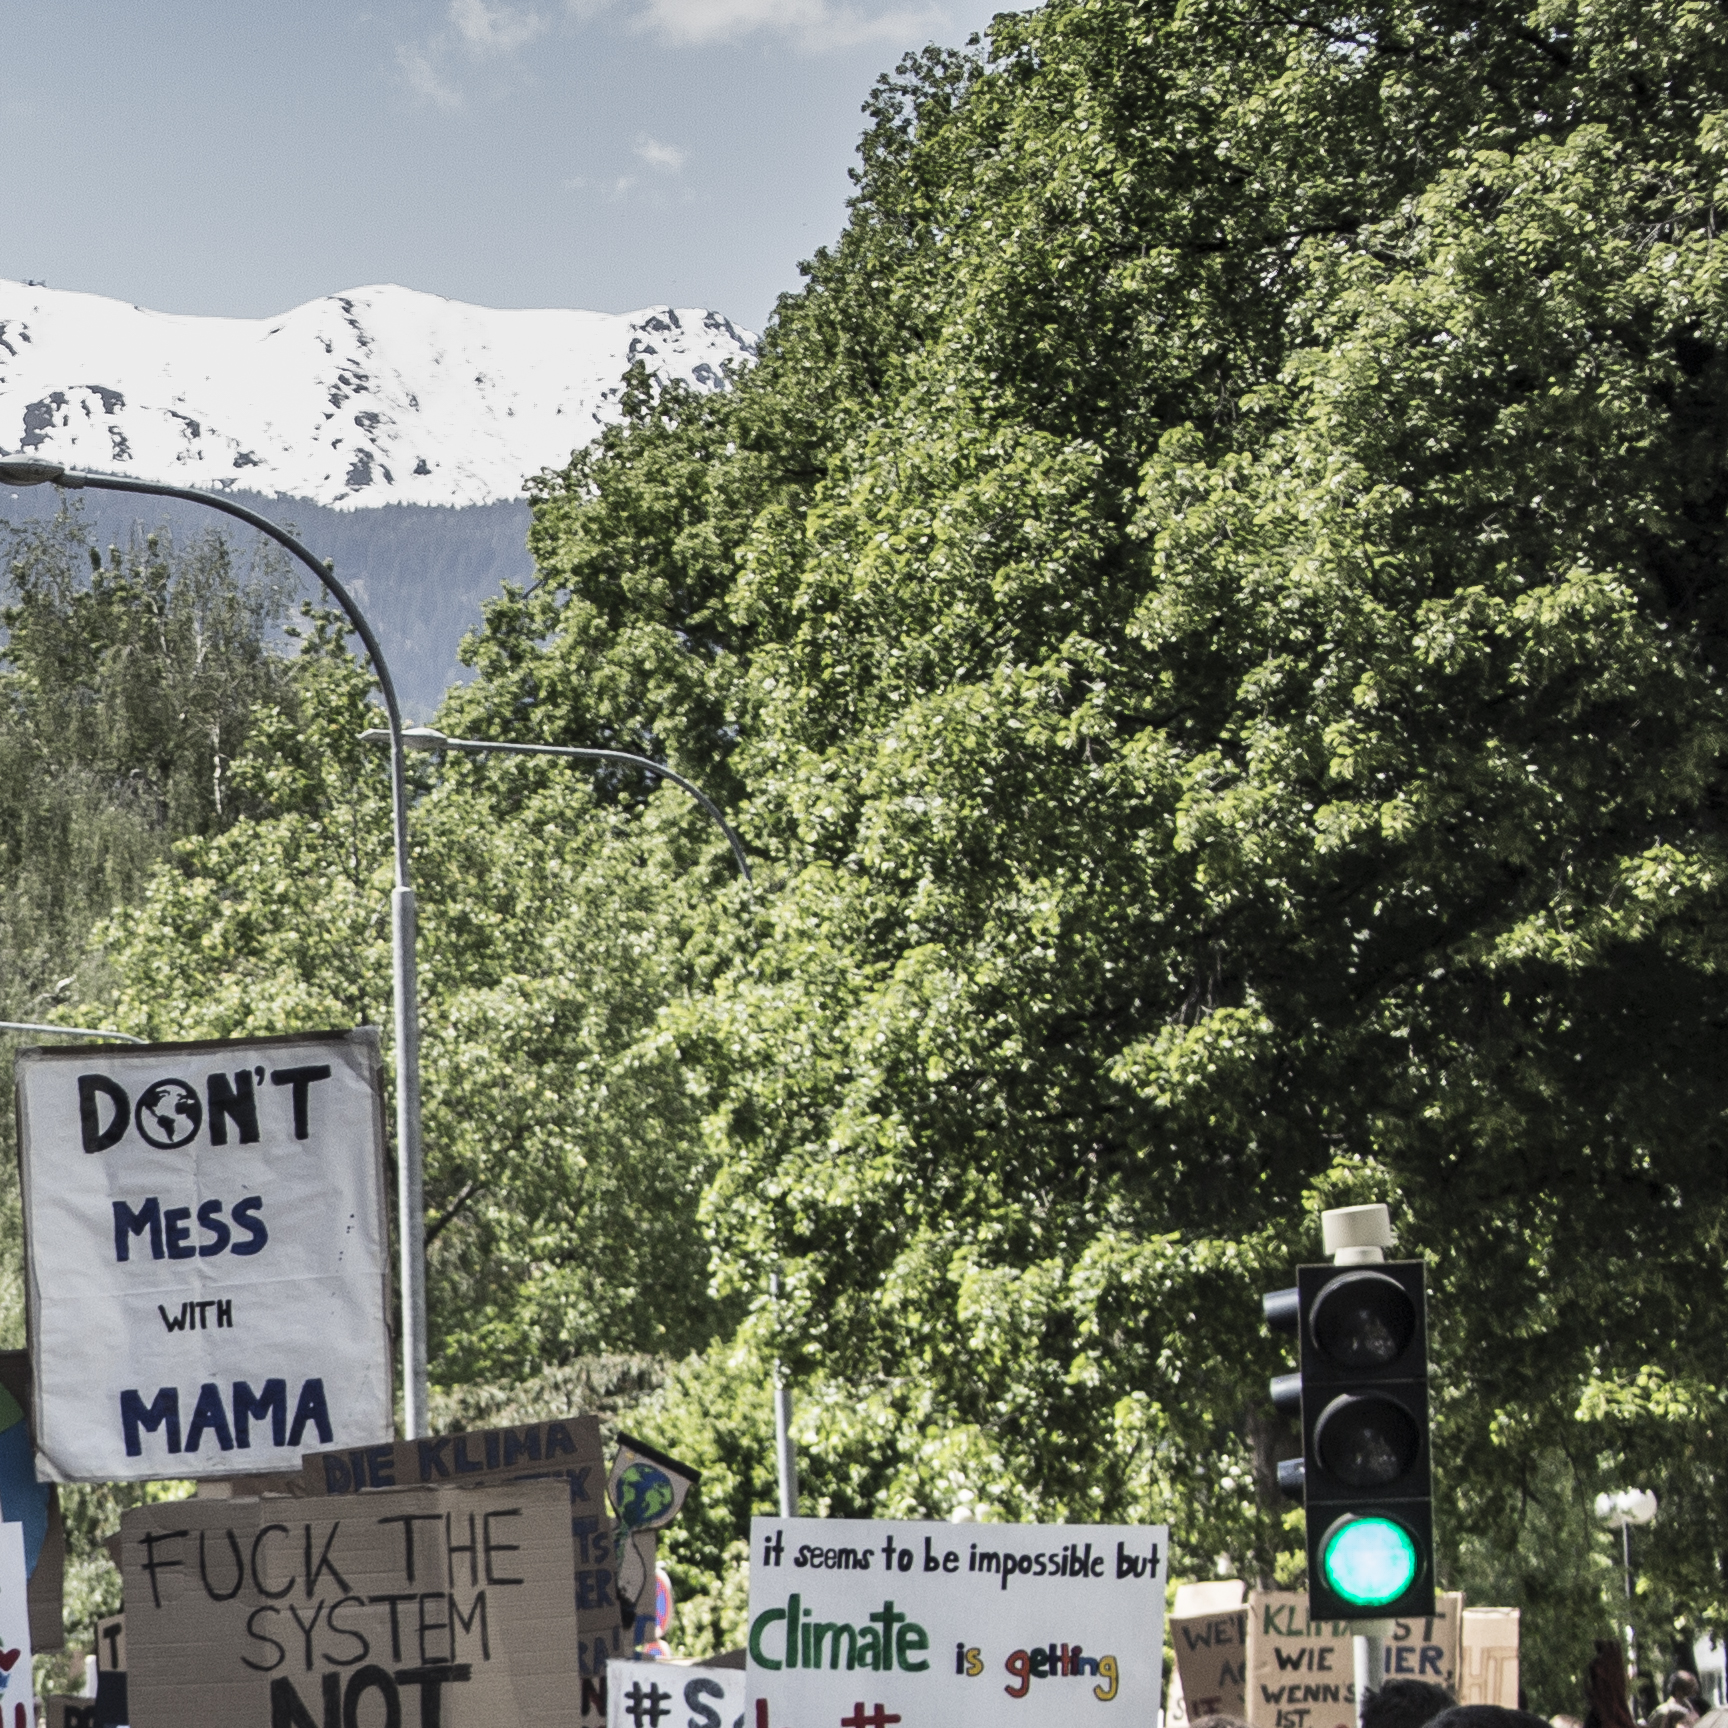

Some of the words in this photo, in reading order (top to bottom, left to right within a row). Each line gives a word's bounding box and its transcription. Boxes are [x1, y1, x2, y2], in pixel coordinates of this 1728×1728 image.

[112, 1196, 269, 1262] MESS
[158, 1299, 233, 1333] WITH
[119, 1378, 334, 1457] MAMA
[418, 1422, 578, 1483] KLIMA
[138, 1518, 352, 1608] FUCK
[377, 1508, 524, 1587] THE
[763, 1530, 785, 1568] it
[794, 1543, 873, 1571] seems
[881, 1535, 914, 1573] to
[923, 1536, 961, 1573] be
[969, 1543, 1105, 1590] impossible
[1116, 1543, 1161, 1581] but
[241, 1590, 489, 1672] SYSTEM
[1274, 1647, 1335, 1672] WIE
[955, 1642, 984, 1678] is
[1004, 1643, 1119, 1701] getting
